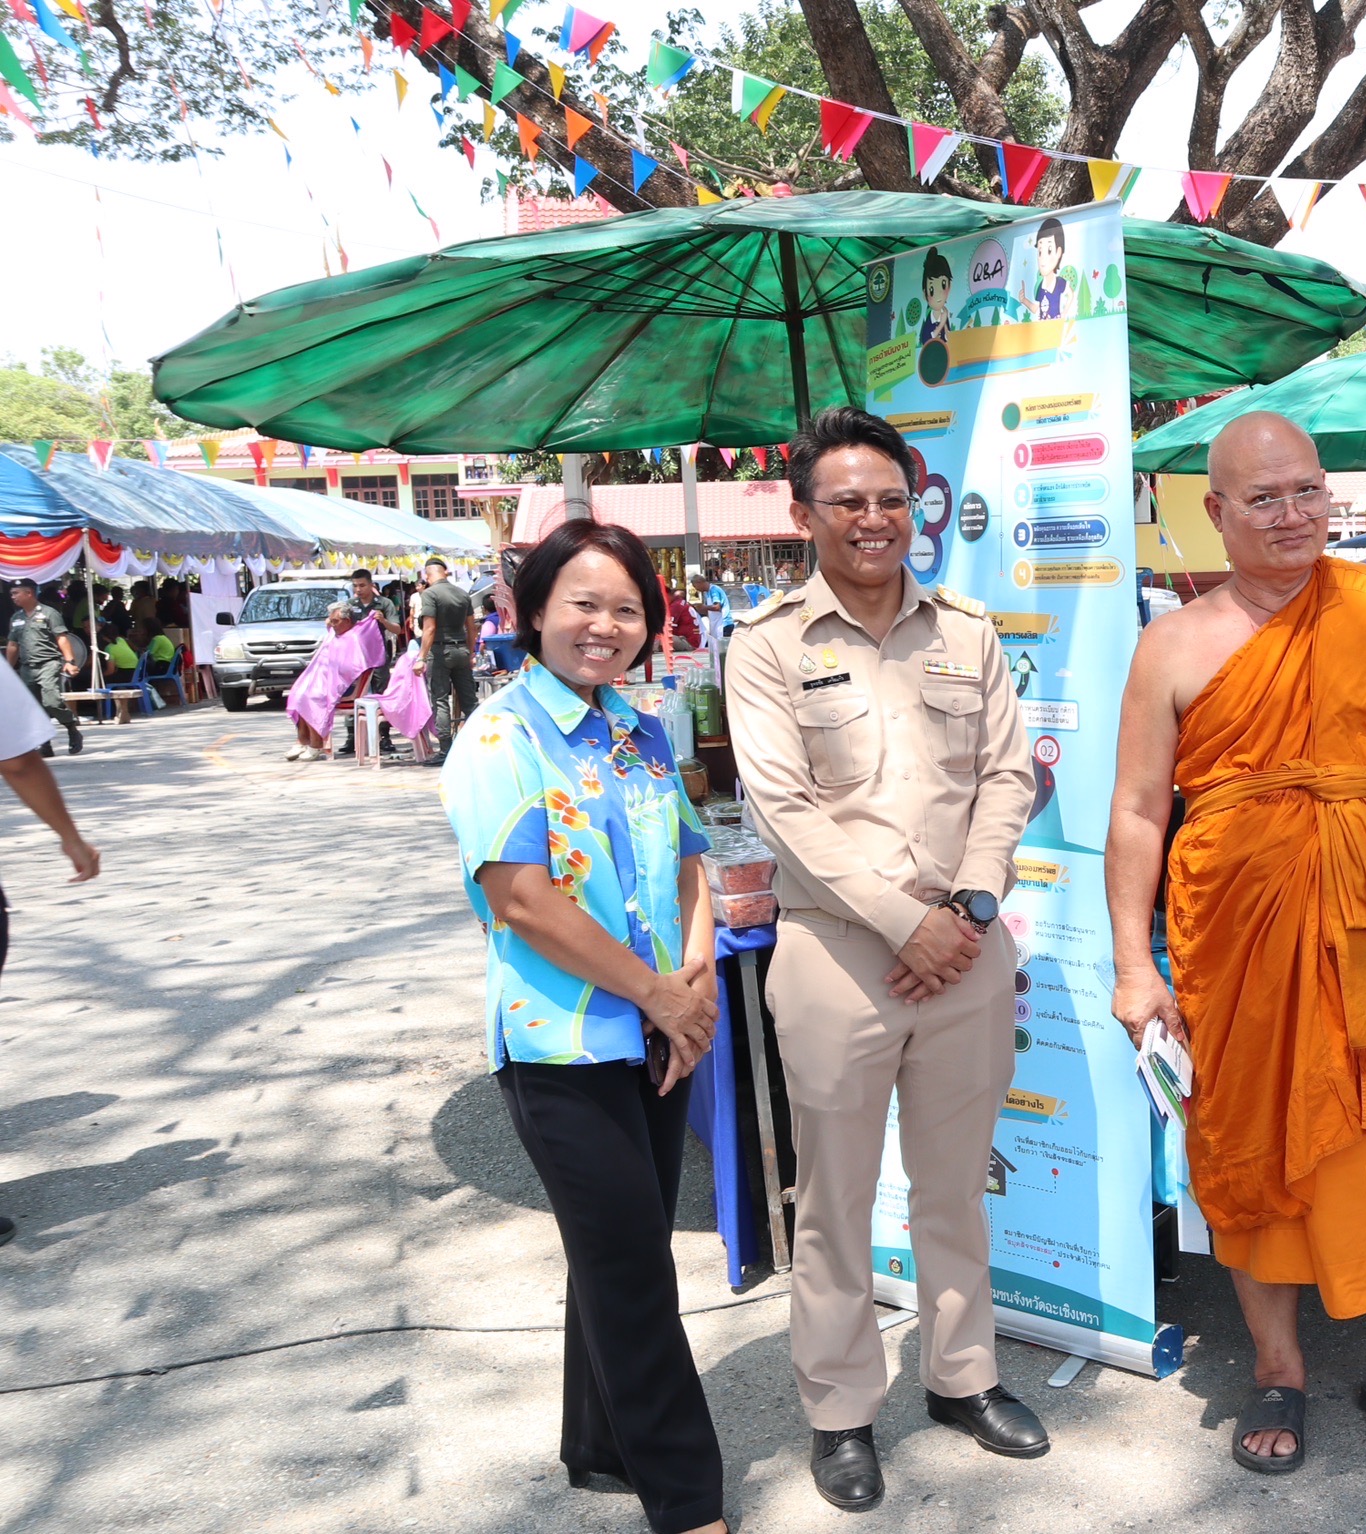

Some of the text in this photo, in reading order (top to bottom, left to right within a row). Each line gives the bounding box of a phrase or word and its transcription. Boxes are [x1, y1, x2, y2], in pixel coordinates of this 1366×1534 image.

[973, 259, 1004, 282] Q&A
[1018, 449, 1024, 463] 1
[1018, 529, 1026, 541] 3
[1018, 568, 1026, 580] 4
[1040, 745, 1054, 757] 02
[1014, 919, 1021, 929] 7
[1005, 1094, 1044, 1110] ได้อย่างไร
